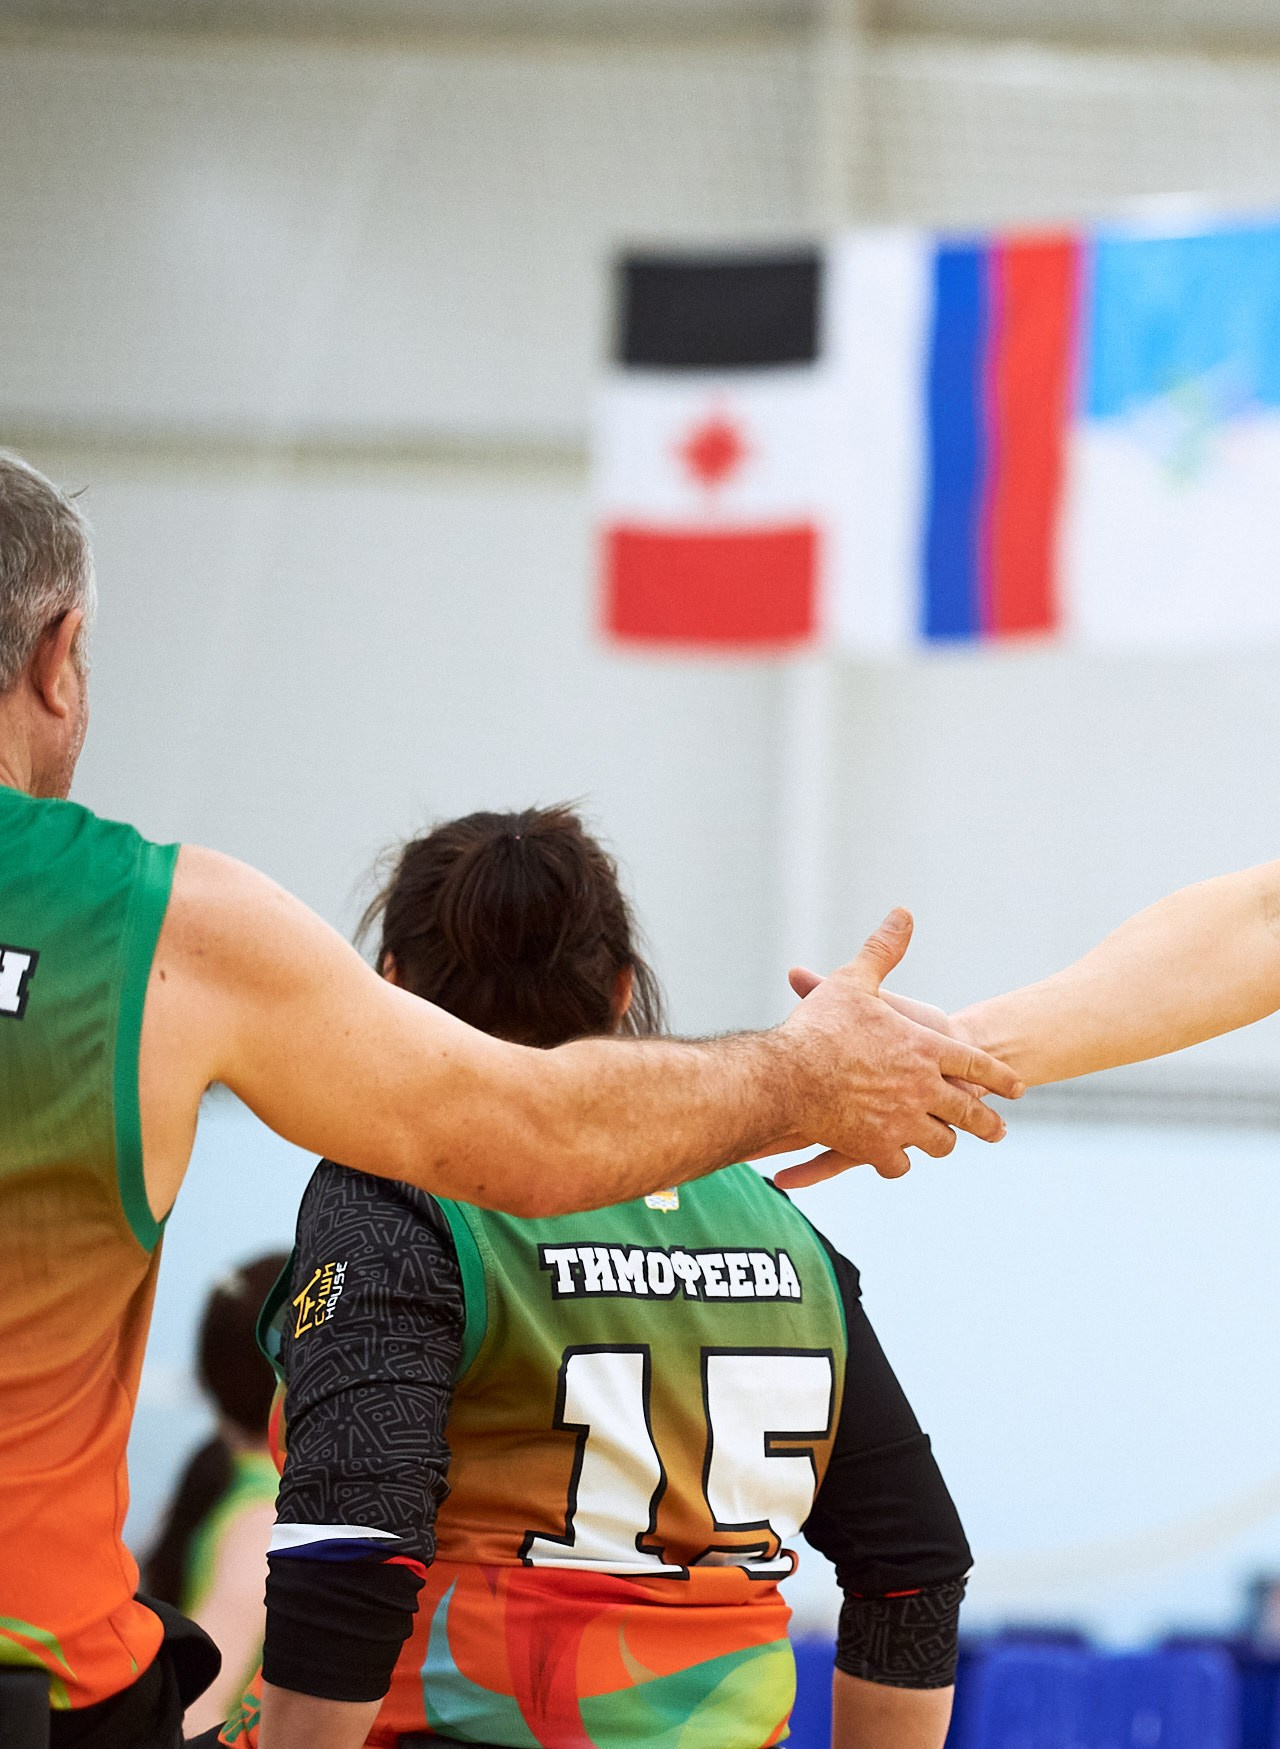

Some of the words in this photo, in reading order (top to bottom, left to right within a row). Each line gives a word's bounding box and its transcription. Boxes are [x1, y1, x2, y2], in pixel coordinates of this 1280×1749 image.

[325, 1261, 348, 1321] HOUSE
[540, 1245, 803, 1301] ТИМОФЕЕВА
[518, 1344, 834, 1580] 15
